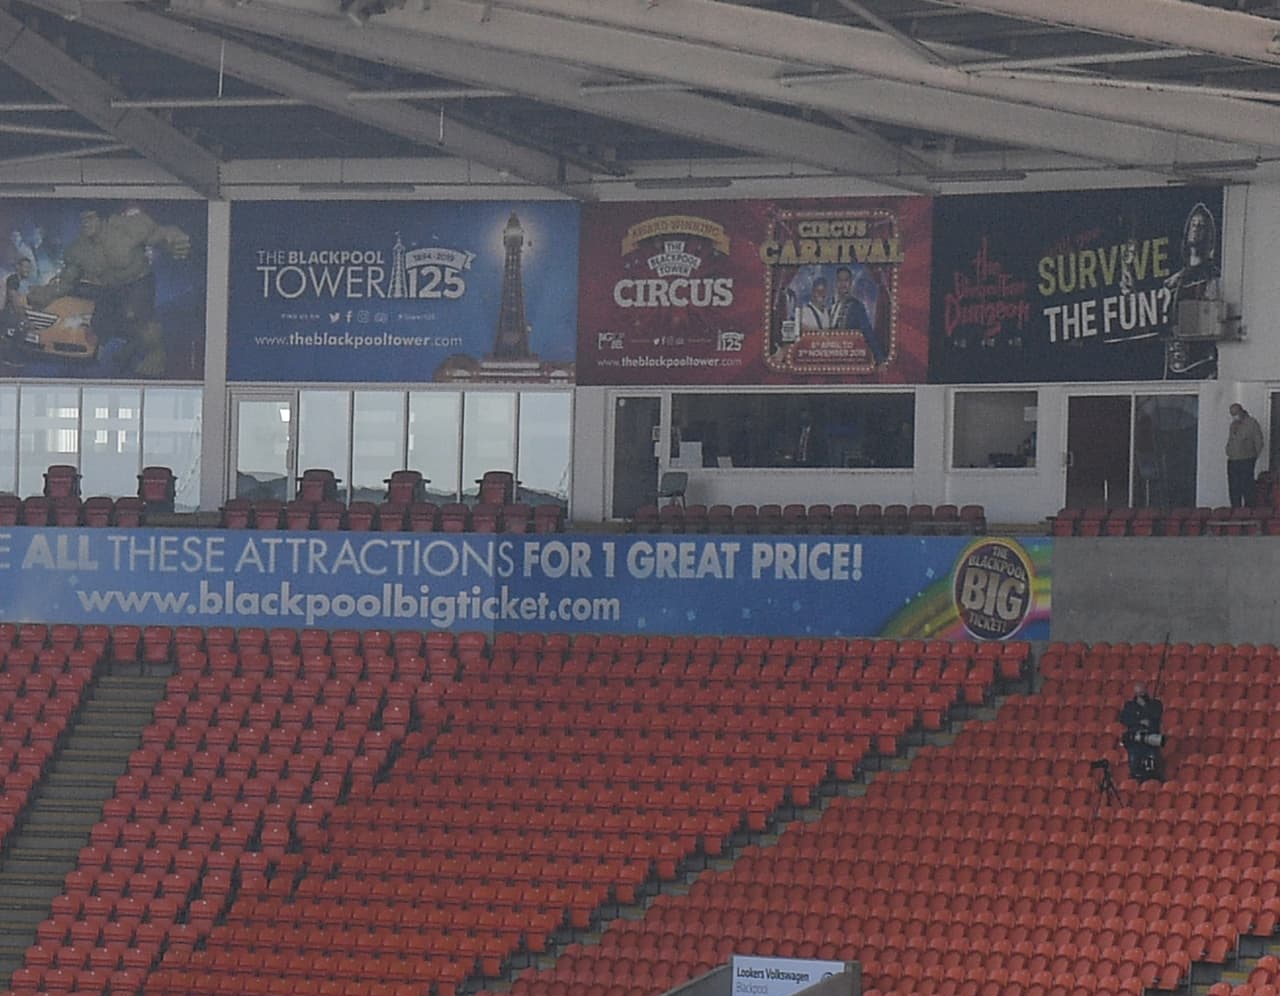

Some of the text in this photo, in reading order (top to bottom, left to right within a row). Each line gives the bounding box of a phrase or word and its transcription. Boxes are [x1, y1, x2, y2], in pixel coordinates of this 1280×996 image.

[256, 250, 385, 265] THE BLACKPOOL
[760, 240, 904, 264] CARNIVAL
[1038, 238, 1170, 296] SURVIVE
[256, 266, 466, 299] TOWER 125
[614, 278, 733, 307] CIRCUS
[1044, 288, 1170, 343] THE FUN?
[255, 332, 462, 349] www.theblackpooltower.com
[22, 534, 99, 571] ALL
[108, 536, 225, 573] THESE
[235, 538, 514, 577] ATTRACTIONS
[523, 541, 592, 578] FOR
[604, 542, 615, 578] 1
[627, 541, 740, 580] GREAT
[752, 543, 863, 581] PRICE!
[968, 555, 1026, 580] BLACKPOOL
[992, 546, 1009, 560] THE
[77, 580, 620, 628] www.blackpoolbigticket.com
[961, 567, 1025, 620] BIG
[736, 967, 810, 984] Lookers Volkswagen
